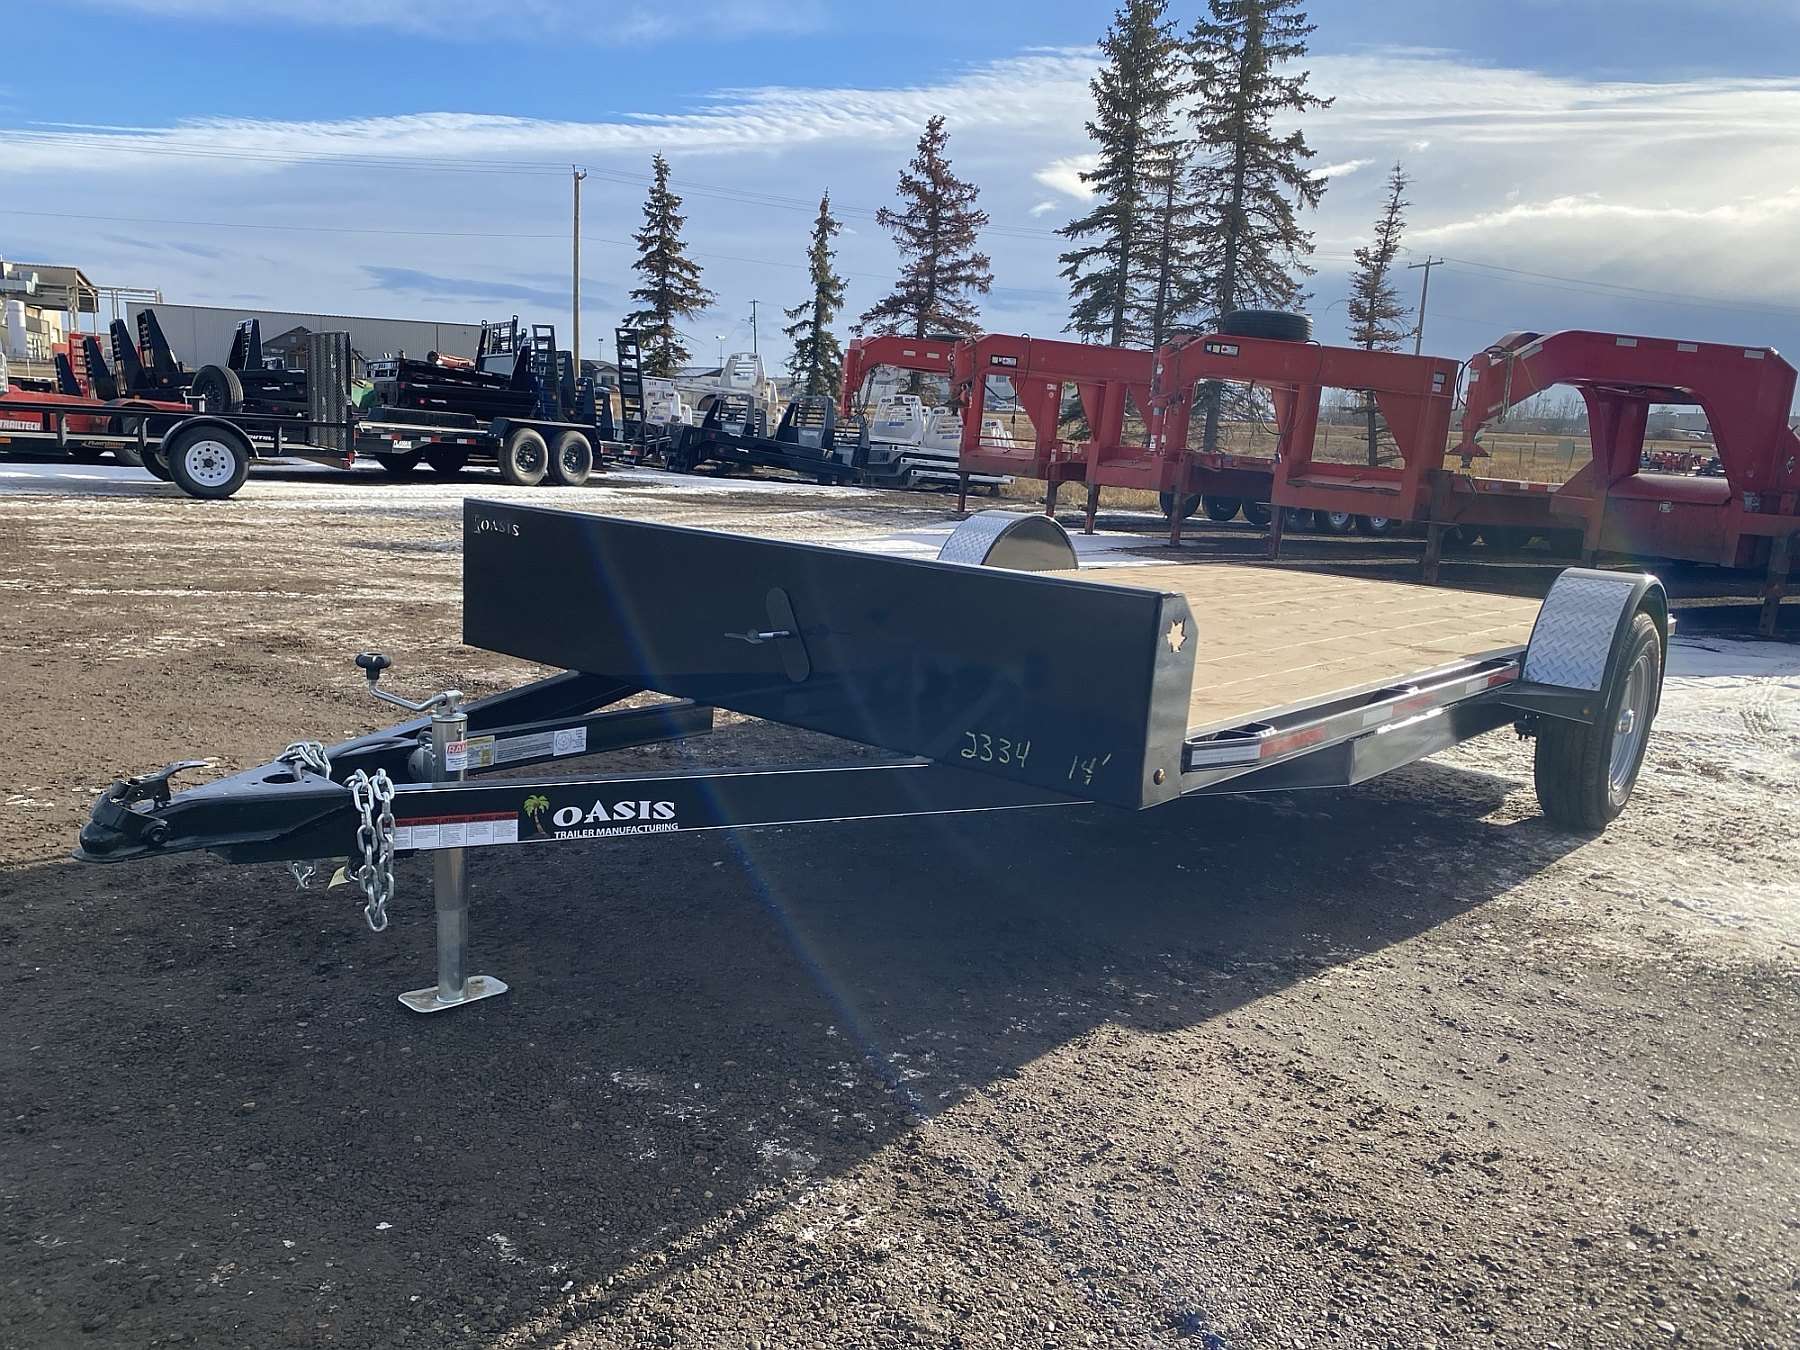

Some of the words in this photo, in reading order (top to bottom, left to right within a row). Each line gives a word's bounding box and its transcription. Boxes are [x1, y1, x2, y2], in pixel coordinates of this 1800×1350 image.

[481, 519, 520, 537] OASIS
[961, 731, 1031, 768] 2334
[552, 799, 676, 827] OASIS
[554, 829, 596, 840] TRAILER
[596, 823, 679, 838] MANUFACTURING
